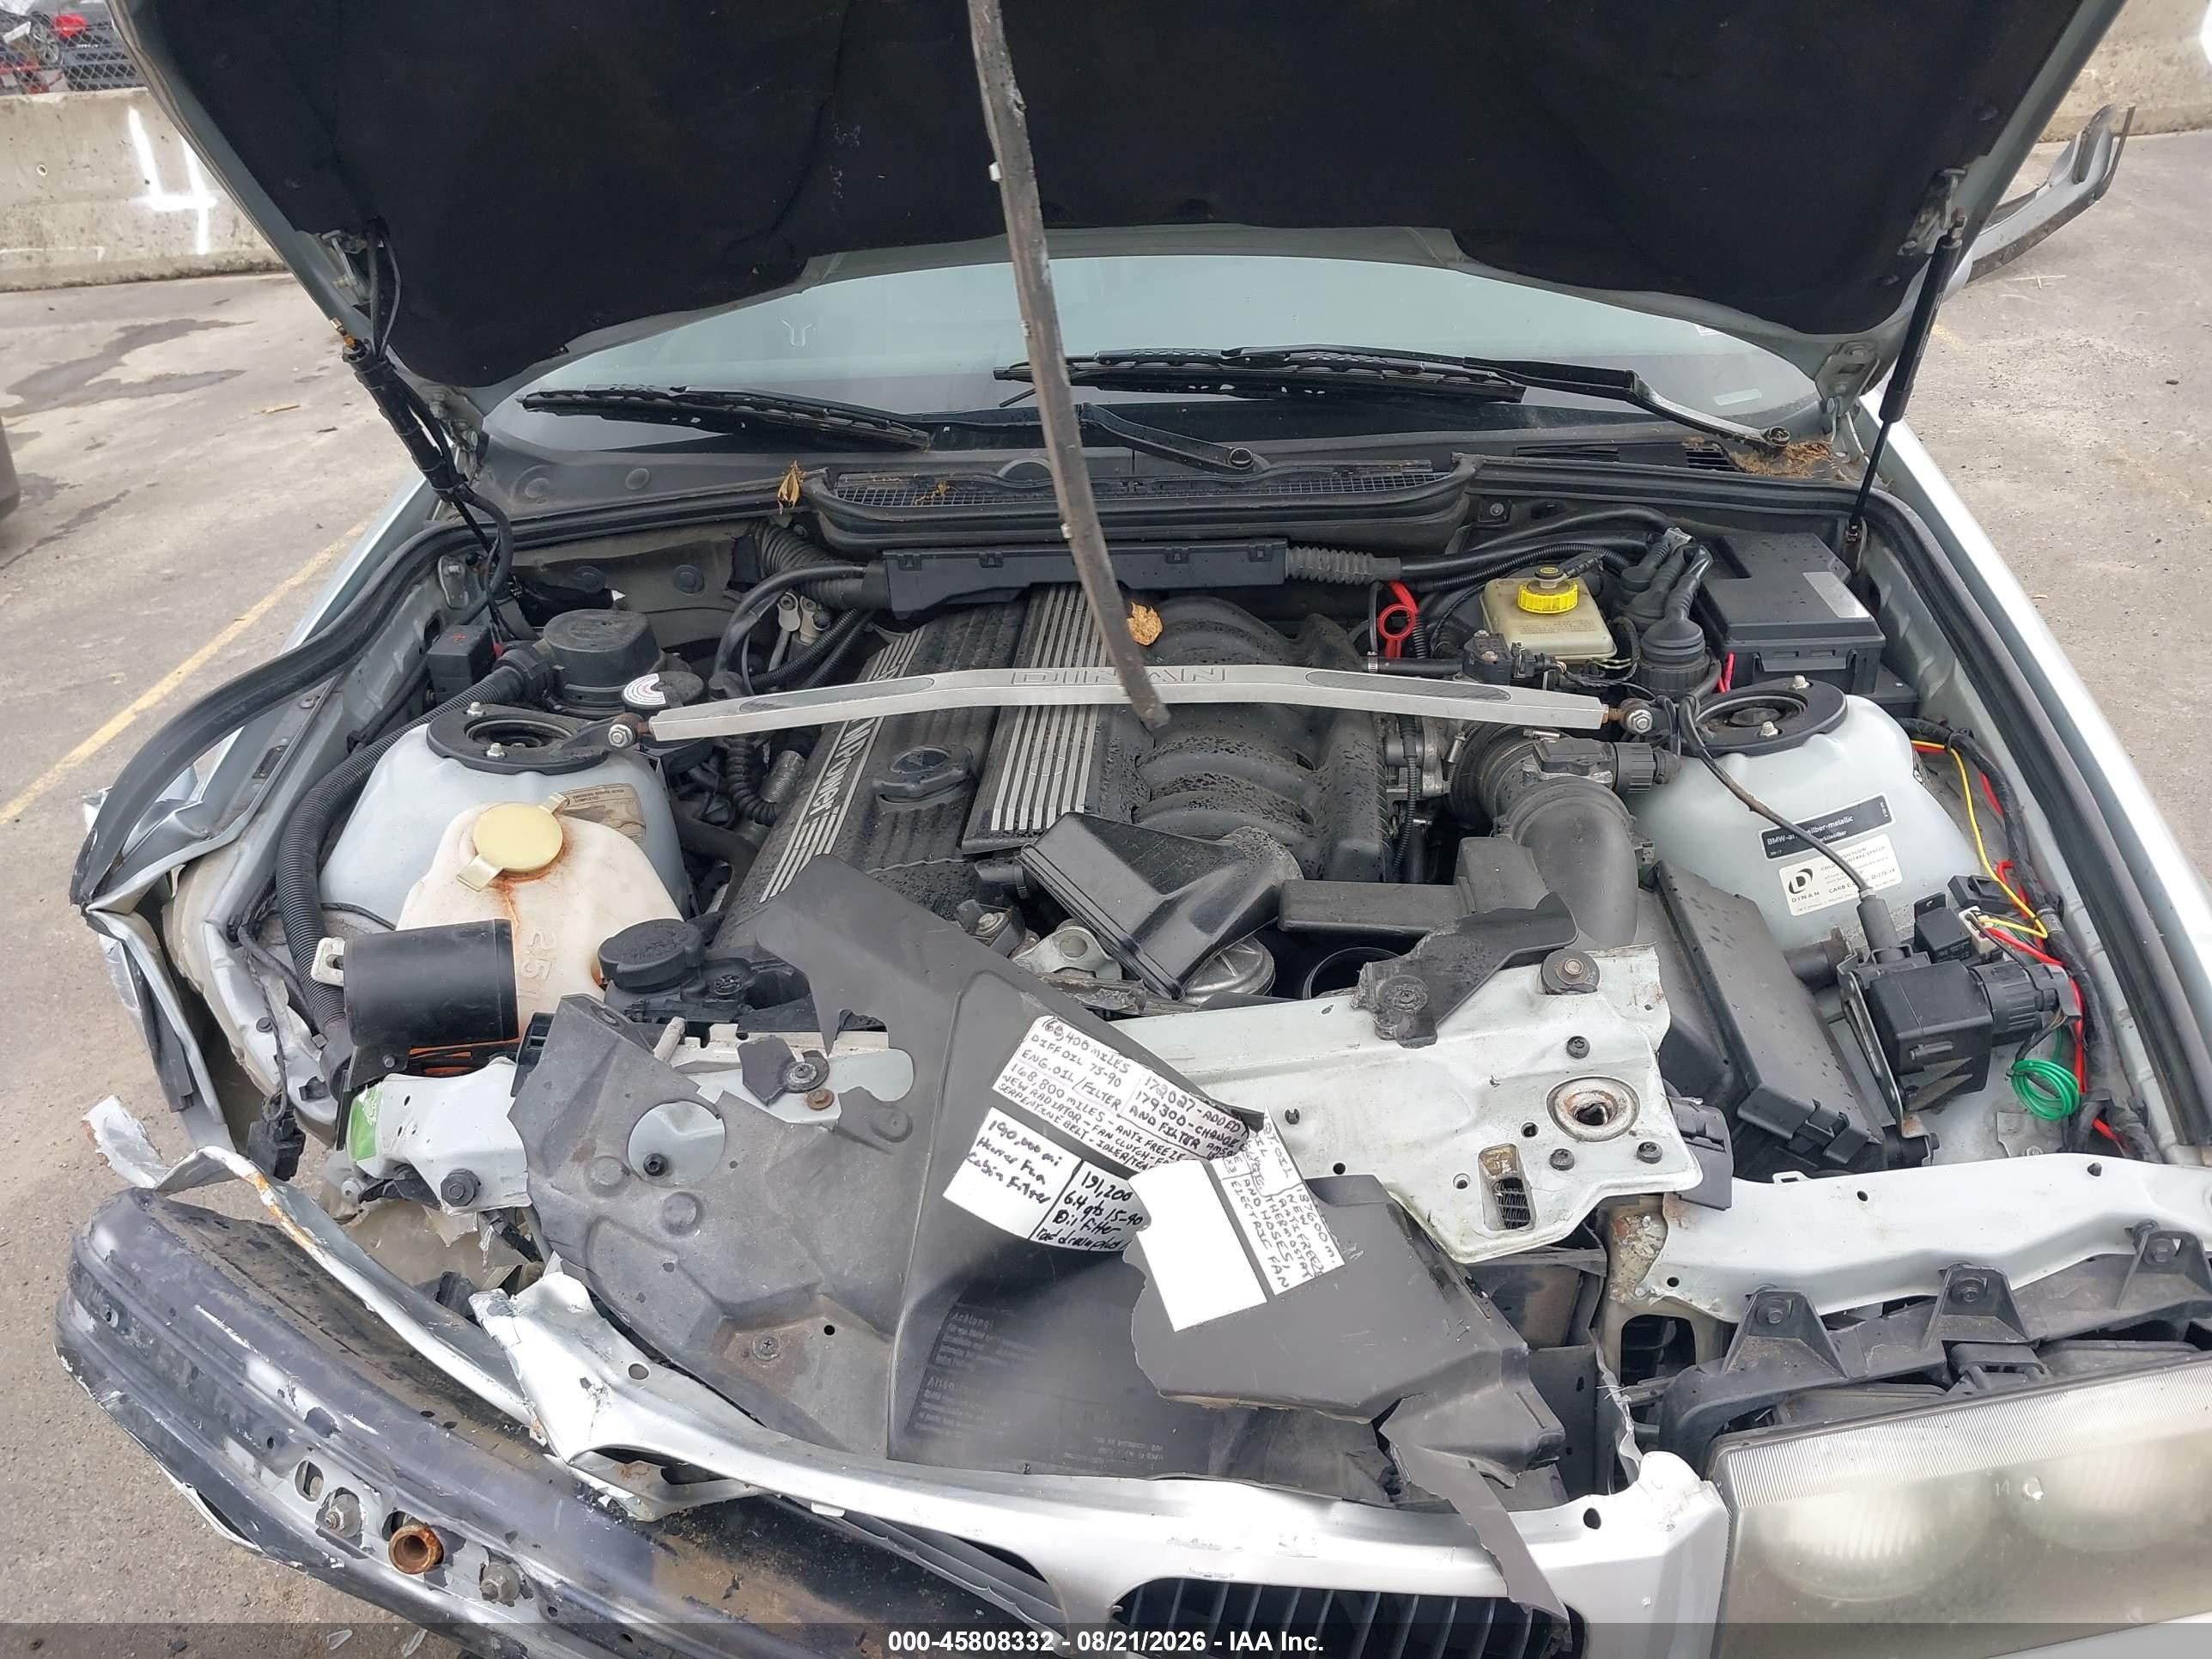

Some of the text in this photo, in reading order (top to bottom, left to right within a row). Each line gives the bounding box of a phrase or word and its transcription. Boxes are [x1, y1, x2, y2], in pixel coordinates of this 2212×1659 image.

[1791, 890, 1820, 903] DINAN
[1089, 1062, 1122, 1088] 75-90
[1002, 1074, 1029, 1092] NEW
[1030, 1088, 1082, 1124] RADIATOR
[1091, 1123, 1115, 1140] FAN
[1011, 1063, 1066, 1099] 168,800
[1066, 1097, 1106, 1122] MILES
[998, 1083, 1064, 1124] SERPENTINE
[1062, 1120, 1090, 1140] BELT
[1128, 1105, 1157, 1127] AND
[1080, 1170, 1133, 1202] 191,200
[1243, 1179, 1261, 1208] AND
[1063, 1190, 1145, 1226] 6.4 qts 15-40
[1286, 1194, 1310, 1226] NEW
[1296, 1188, 1328, 1243] 187600
[1265, 1195, 1314, 1279] THERMOSTAT
[1267, 1255, 1291, 1289] FAN
